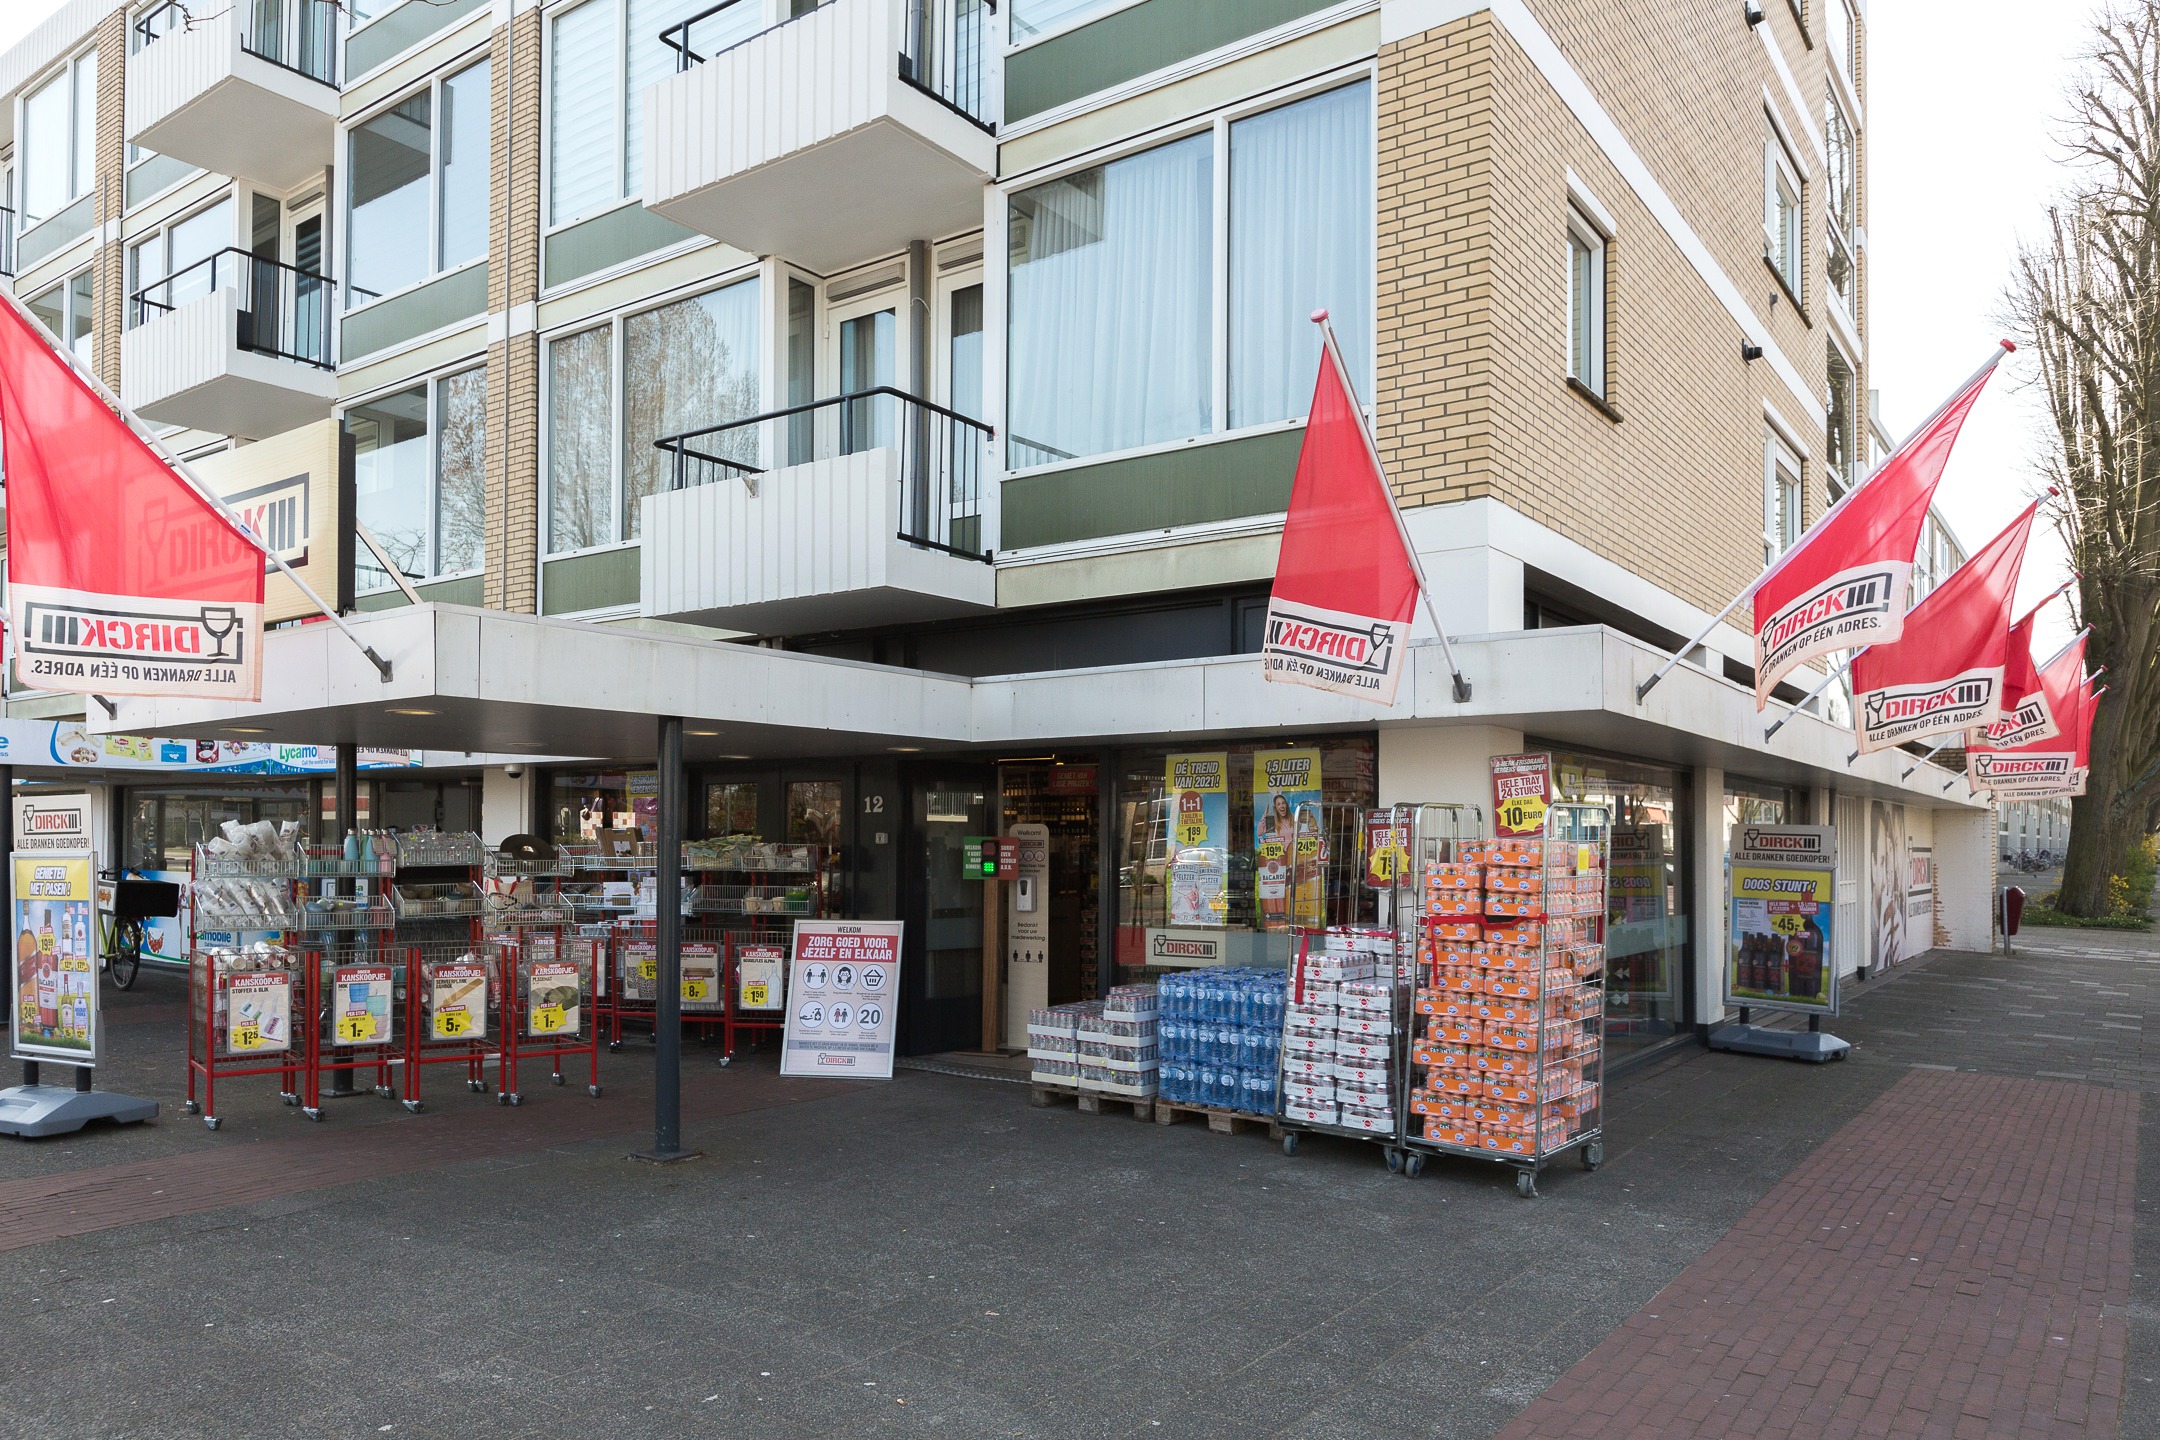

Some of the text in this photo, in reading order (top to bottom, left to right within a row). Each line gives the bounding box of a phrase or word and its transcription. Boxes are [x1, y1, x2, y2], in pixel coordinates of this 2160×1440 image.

[1768, 617, 1881, 674] DRANKEN OP ÉÉN ADRES.
[1869, 731, 1885, 743] ALLE
[1887, 722, 1920, 739] DRANKEN
[1919, 719, 1931, 729] OP
[1932, 713, 1950, 726] ÉÉN
[1174, 758, 1219, 775] DÉ TREND
[1266, 759, 1280, 774] 1,5
[1281, 758, 1311, 773] LITER
[1174, 775, 1193, 789] VAN
[1268, 773, 1303, 787] STUNT
[1500, 776, 1540, 789] HELE TRAY
[1993, 777, 2017, 785] DRANKEN
[1501, 785, 1542, 799] 24 STUKS!
[864, 796, 884, 813] 12
[1181, 797, 1201, 811] 1+1
[1504, 807, 1542, 826] 10 EURO
[17, 837, 90, 849] ALLE DRANKEN GOEDKOPER!
[1734, 852, 1830, 864] ALLE DRANKEN GOEDKOPER!
[34, 865, 67, 881] GENIETEN
[29, 881, 67, 896] MET PASEN
[1743, 877, 1772, 891] DOOS
[1773, 878, 1811, 893] STUNT
[187, 925, 232, 943] Lcamobile
[837, 926, 862, 934] WELKOM
[808, 936, 888, 949] ZORG GOED VOOR
[801, 947, 893, 960] JEZELF EN ELKAAR
[341, 973, 386, 981] KANSKOOPJE!
[439, 970, 481, 978] KANSKOOPJE!
[534, 967, 575, 976] KANSKOOPJE!
[235, 977, 283, 987] KANSKOOPJE!
[859, 1009, 881, 1025] 20
